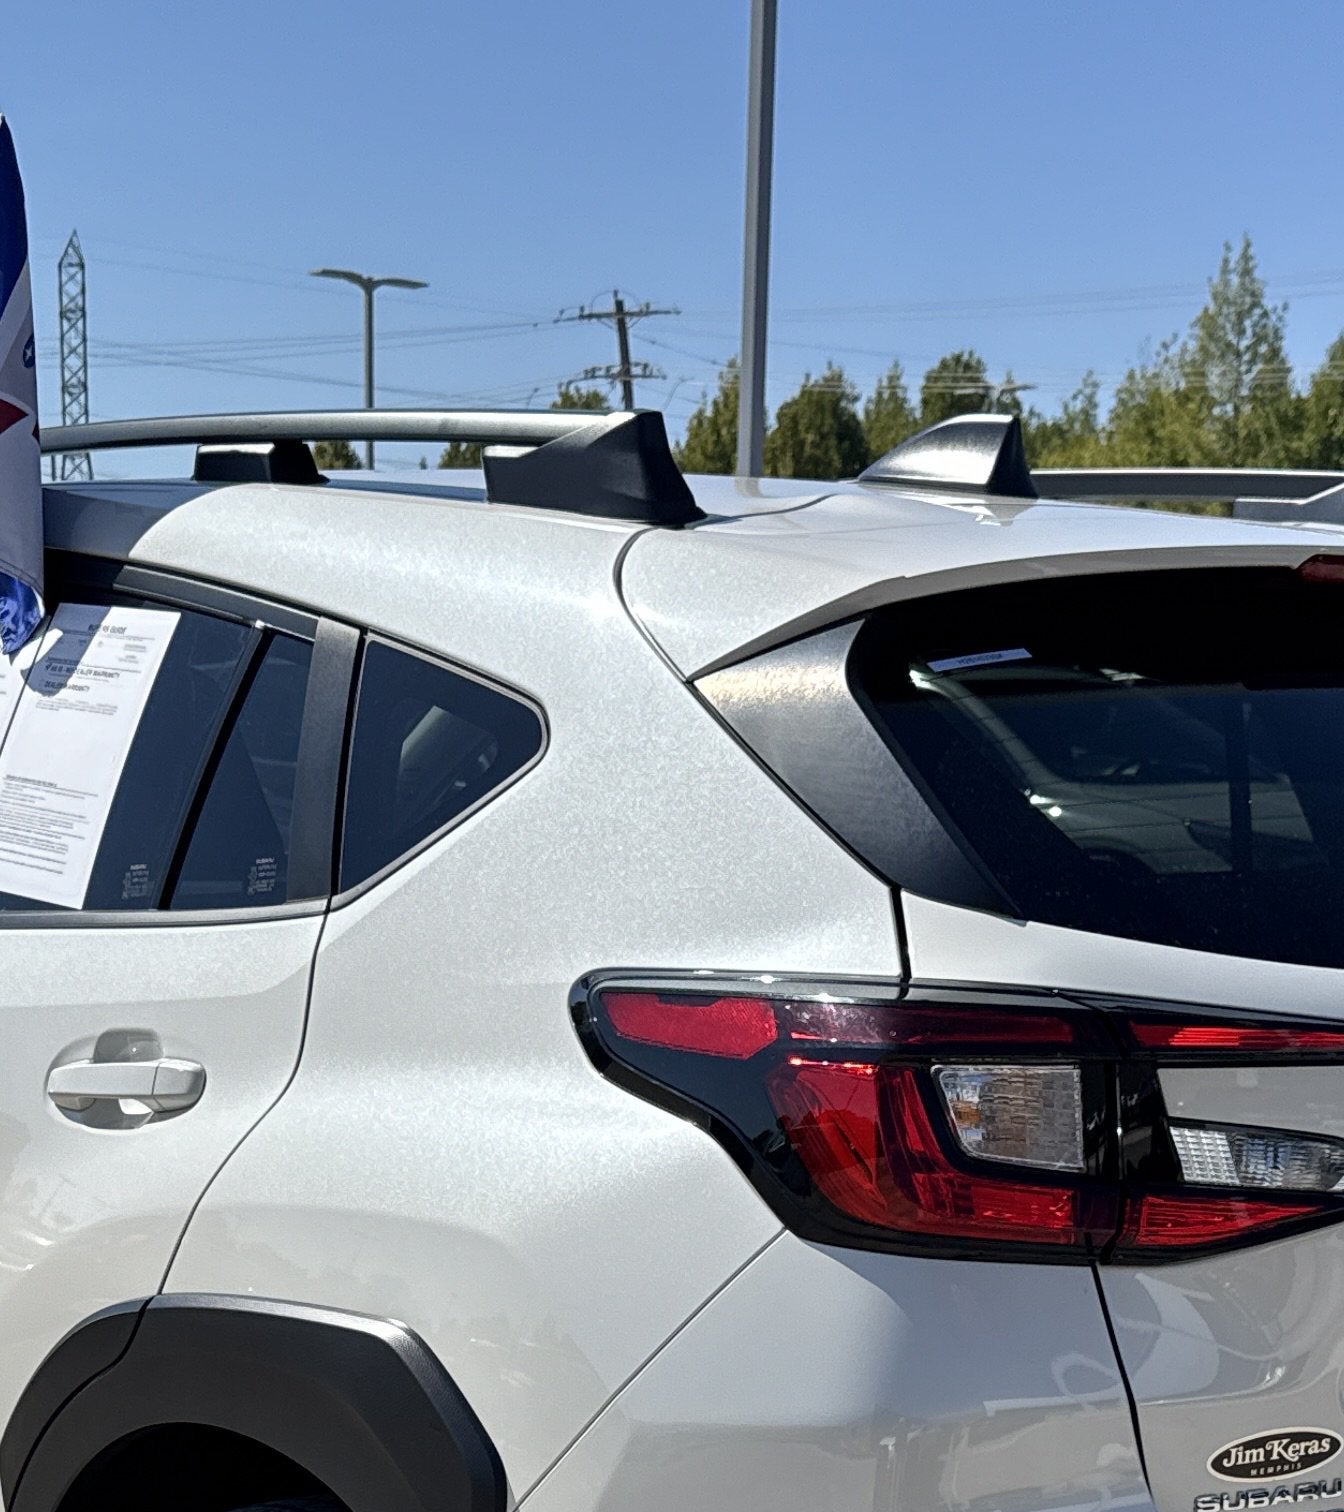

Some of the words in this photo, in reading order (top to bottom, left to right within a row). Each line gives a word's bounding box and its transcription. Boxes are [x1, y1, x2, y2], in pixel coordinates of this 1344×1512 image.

[1222, 1446, 1265, 1467] Jim
[1265, 1438, 1331, 1462] Keras
[1250, 1462, 1302, 1476] MEMPHIS
